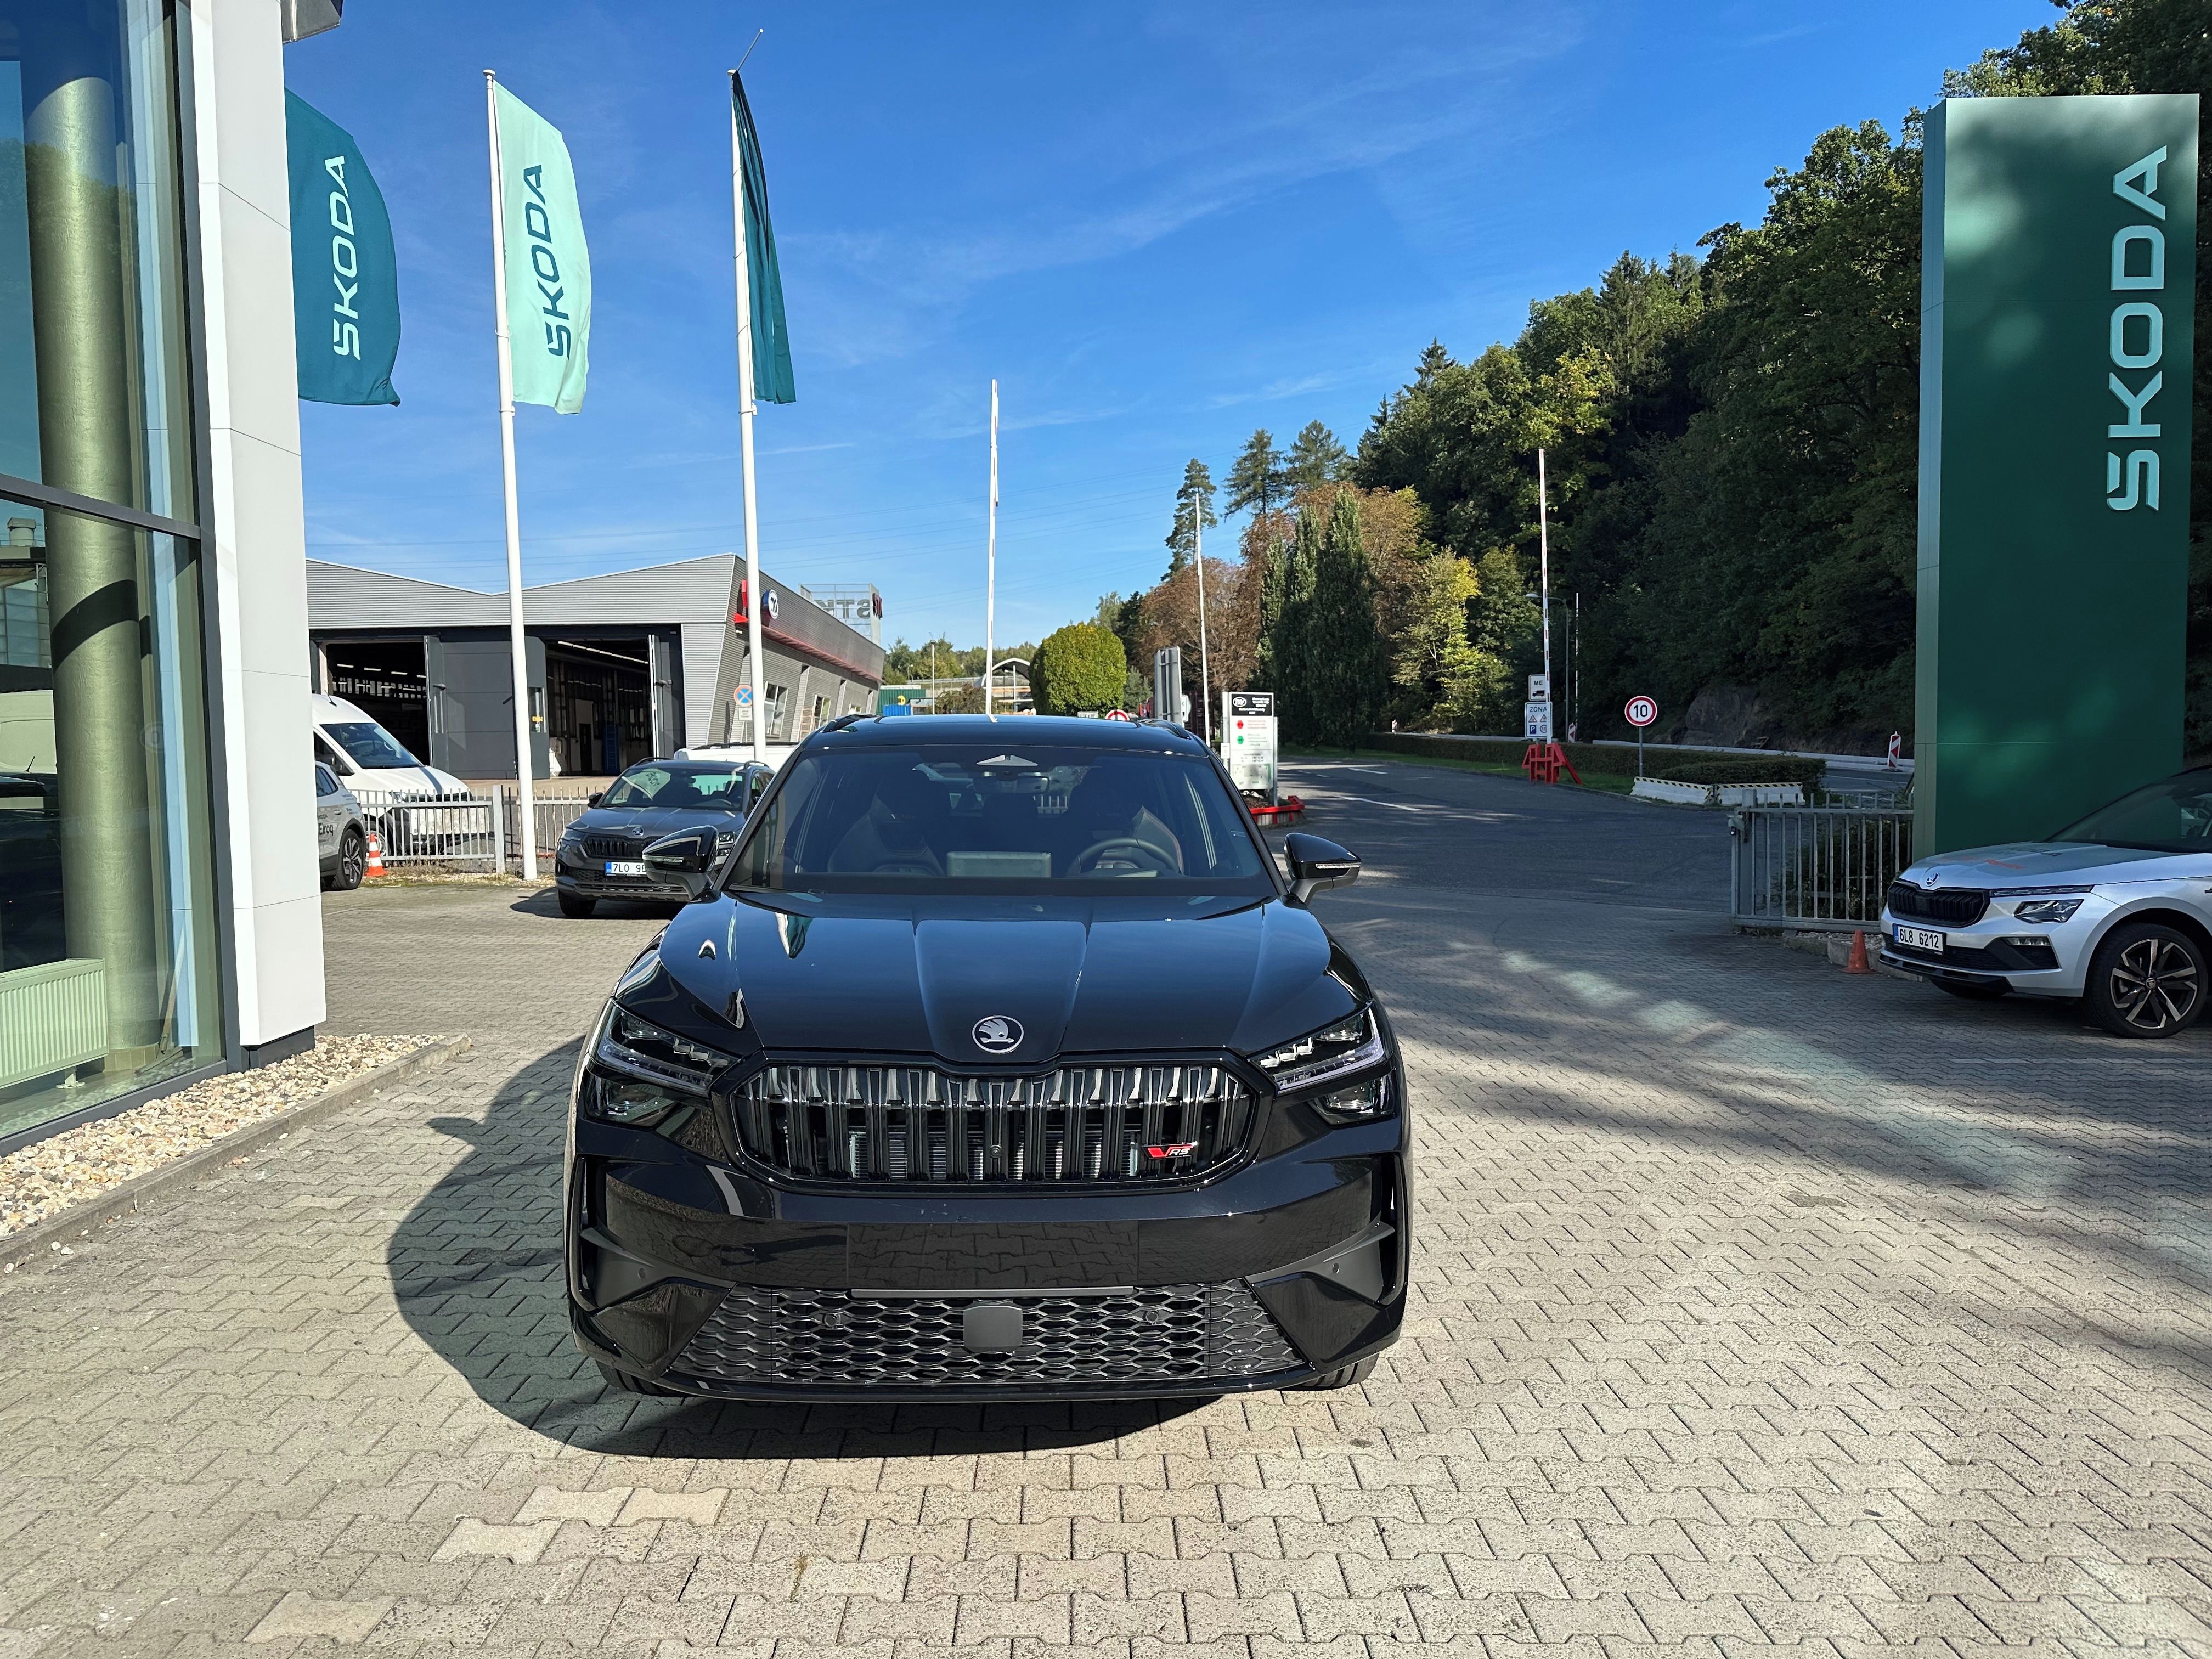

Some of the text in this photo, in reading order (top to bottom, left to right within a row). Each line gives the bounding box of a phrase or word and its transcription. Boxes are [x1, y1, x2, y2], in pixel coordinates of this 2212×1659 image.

[1634, 704, 1648, 718] 10
[319, 823, 334, 837] Elroq
[1900, 928, 1939, 949] 6L8 6212
